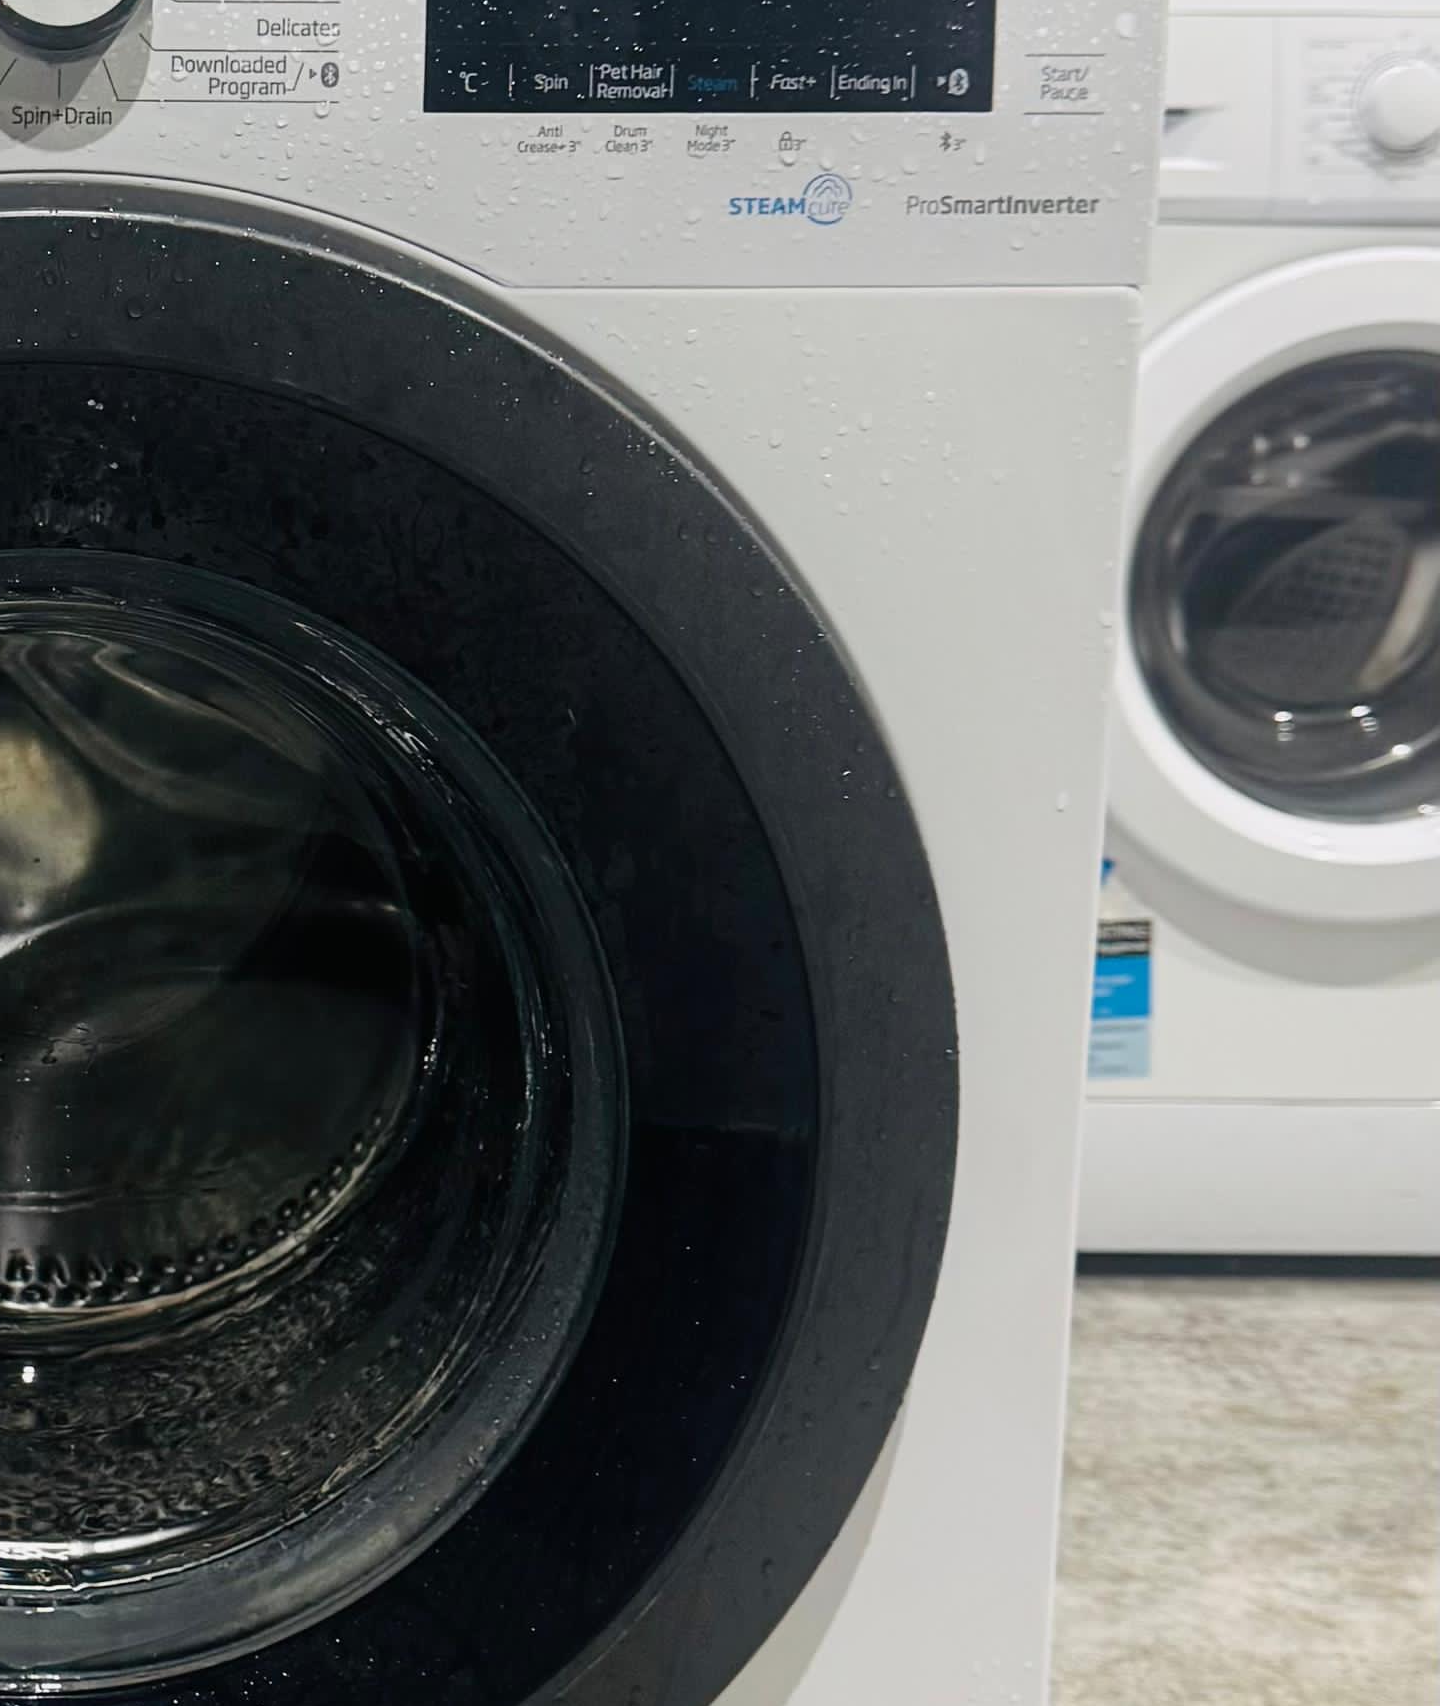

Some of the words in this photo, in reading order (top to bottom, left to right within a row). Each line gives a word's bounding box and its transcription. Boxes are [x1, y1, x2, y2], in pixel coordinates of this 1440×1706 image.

[257, 18, 341, 37] Delicates
[171, 55, 287, 74] Downloaded
[600, 63, 629, 79] Pet
[631, 64, 663, 79] Hair
[209, 77, 286, 99] Program
[534, 73, 568, 92] Spin
[597, 82, 666, 99] Removal
[687, 74, 738, 91] Steam
[838, 75, 890, 94] Ending
[892, 77, 907, 91] In
[1041, 86, 1088, 102] Pause
[11, 106, 113, 129] Spin+Drain
[537, 124, 564, 138] Anti
[614, 124, 648, 138] Drum
[696, 124, 728, 139] Night
[605, 140, 639, 153] Clean
[688, 140, 721, 153] Mode
